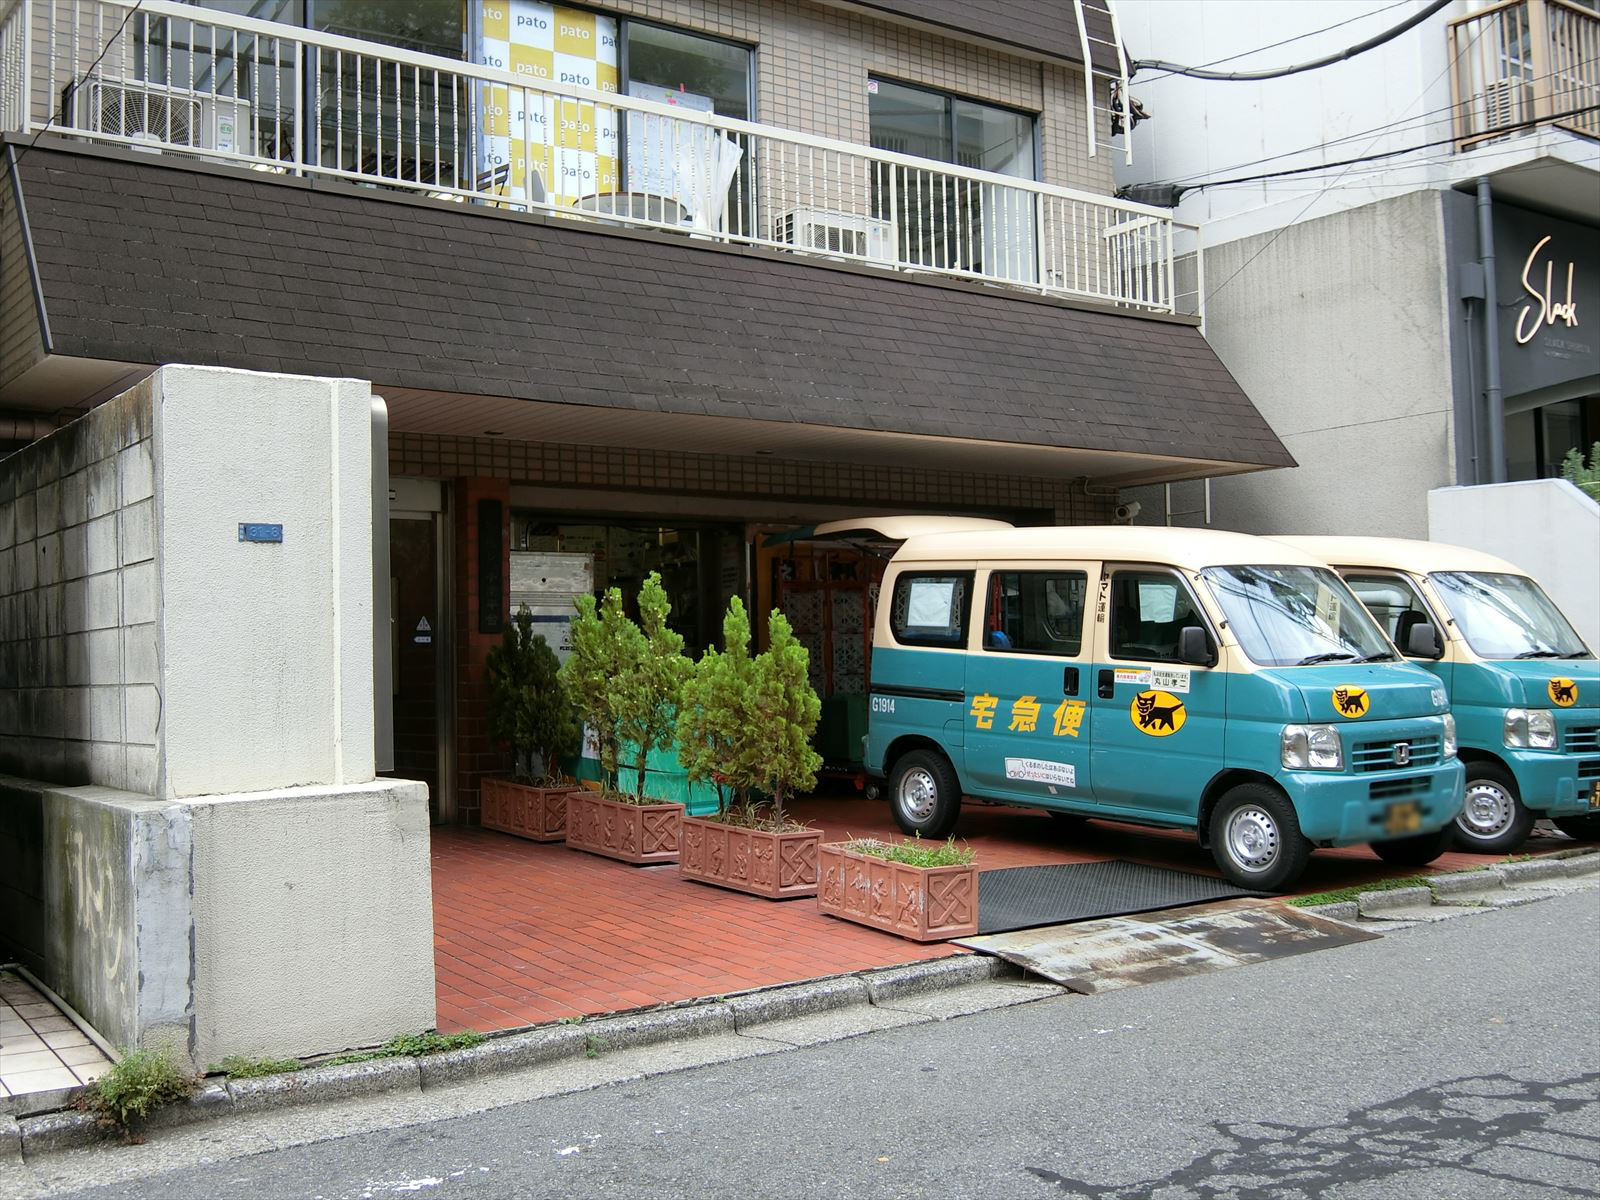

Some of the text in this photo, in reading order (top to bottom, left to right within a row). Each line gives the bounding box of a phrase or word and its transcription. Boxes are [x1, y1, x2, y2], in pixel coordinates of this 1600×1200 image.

[482, 7, 503, 20] ato
[517, 15, 547, 30] pato
[559, 24, 590, 39] pato
[482, 55, 503, 68] ato
[516, 62, 547, 77] pato
[560, 71, 590, 86] pato
[872, 696, 896, 714] G1914
[969, 692, 1087, 738] 宅急便
